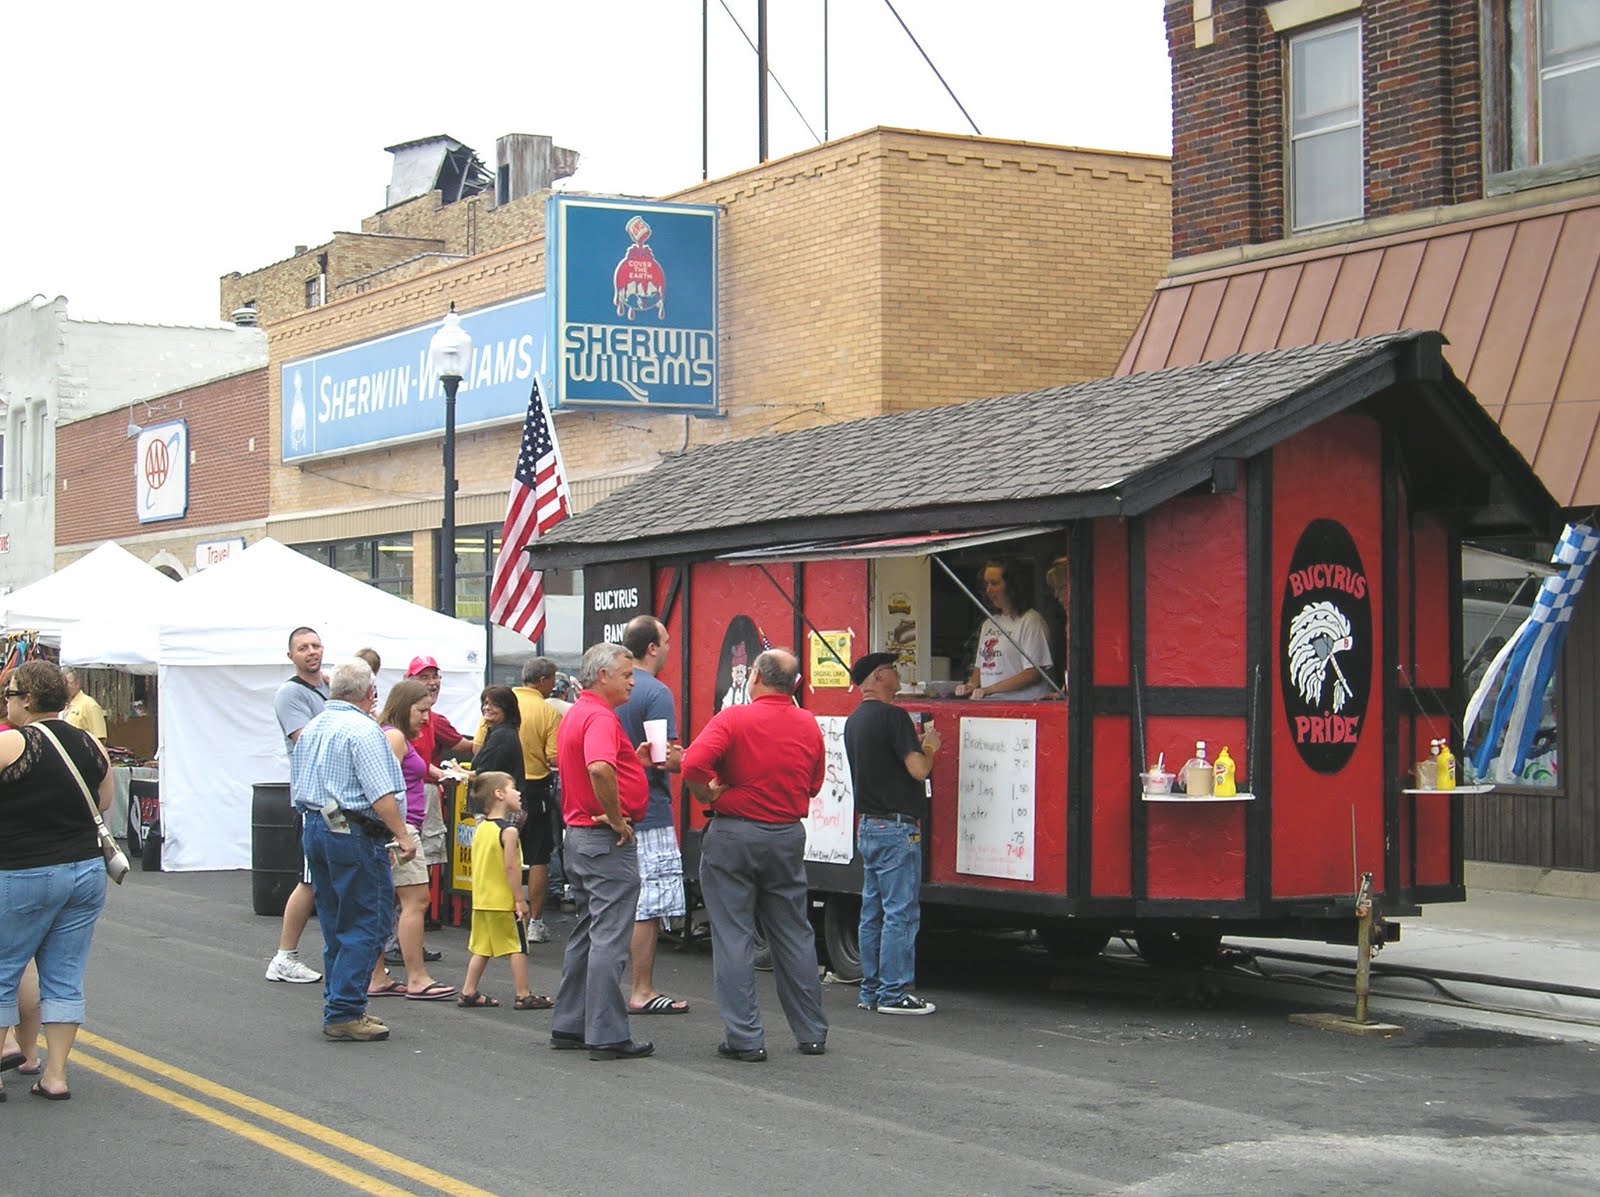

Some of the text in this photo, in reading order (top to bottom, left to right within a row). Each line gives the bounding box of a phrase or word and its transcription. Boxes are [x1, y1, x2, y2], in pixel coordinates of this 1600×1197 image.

[565, 325, 714, 360] SHERWIN
[207, 542, 230, 565] Travel
[1290, 564, 1366, 599] BUCYRUS
[594, 587, 638, 612] BUCYRUS
[1343, 638, 1349, 648] B
